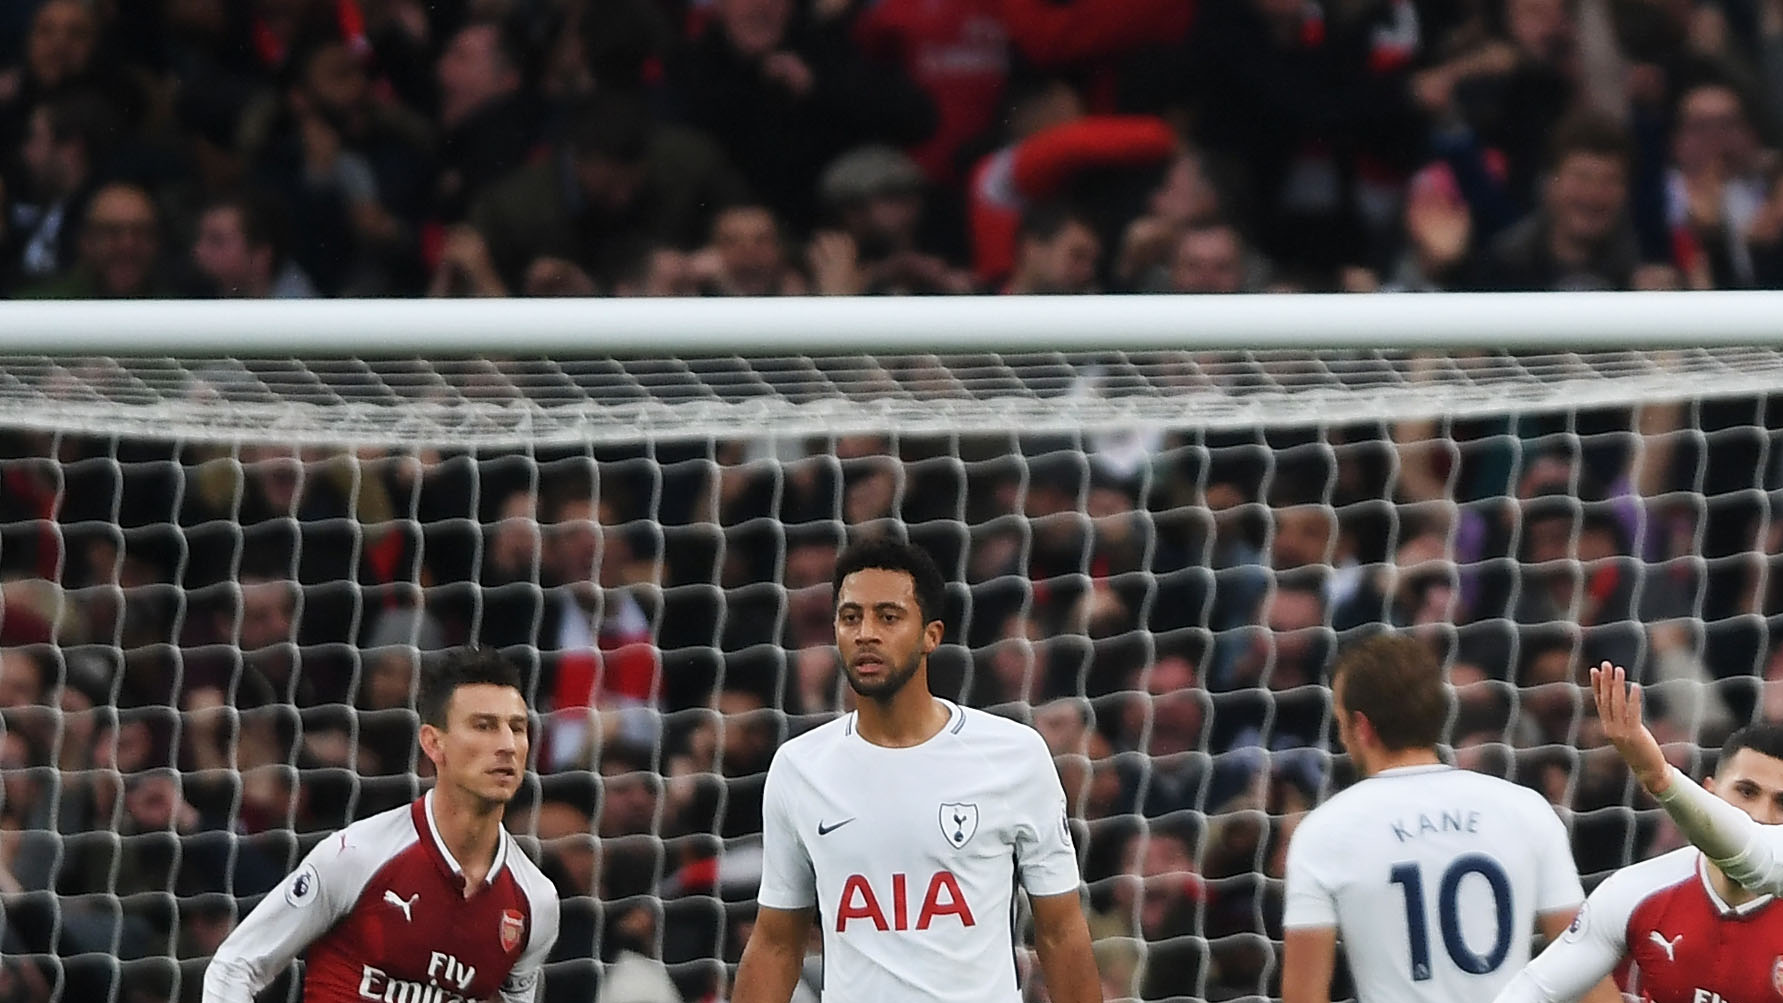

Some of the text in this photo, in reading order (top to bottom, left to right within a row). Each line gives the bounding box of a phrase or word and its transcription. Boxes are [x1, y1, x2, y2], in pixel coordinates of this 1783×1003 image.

[1389, 810, 1481, 842] KANE
[835, 870, 976, 933] AIA
[1389, 851, 1514, 982] 10
[427, 951, 476, 990] Fly
